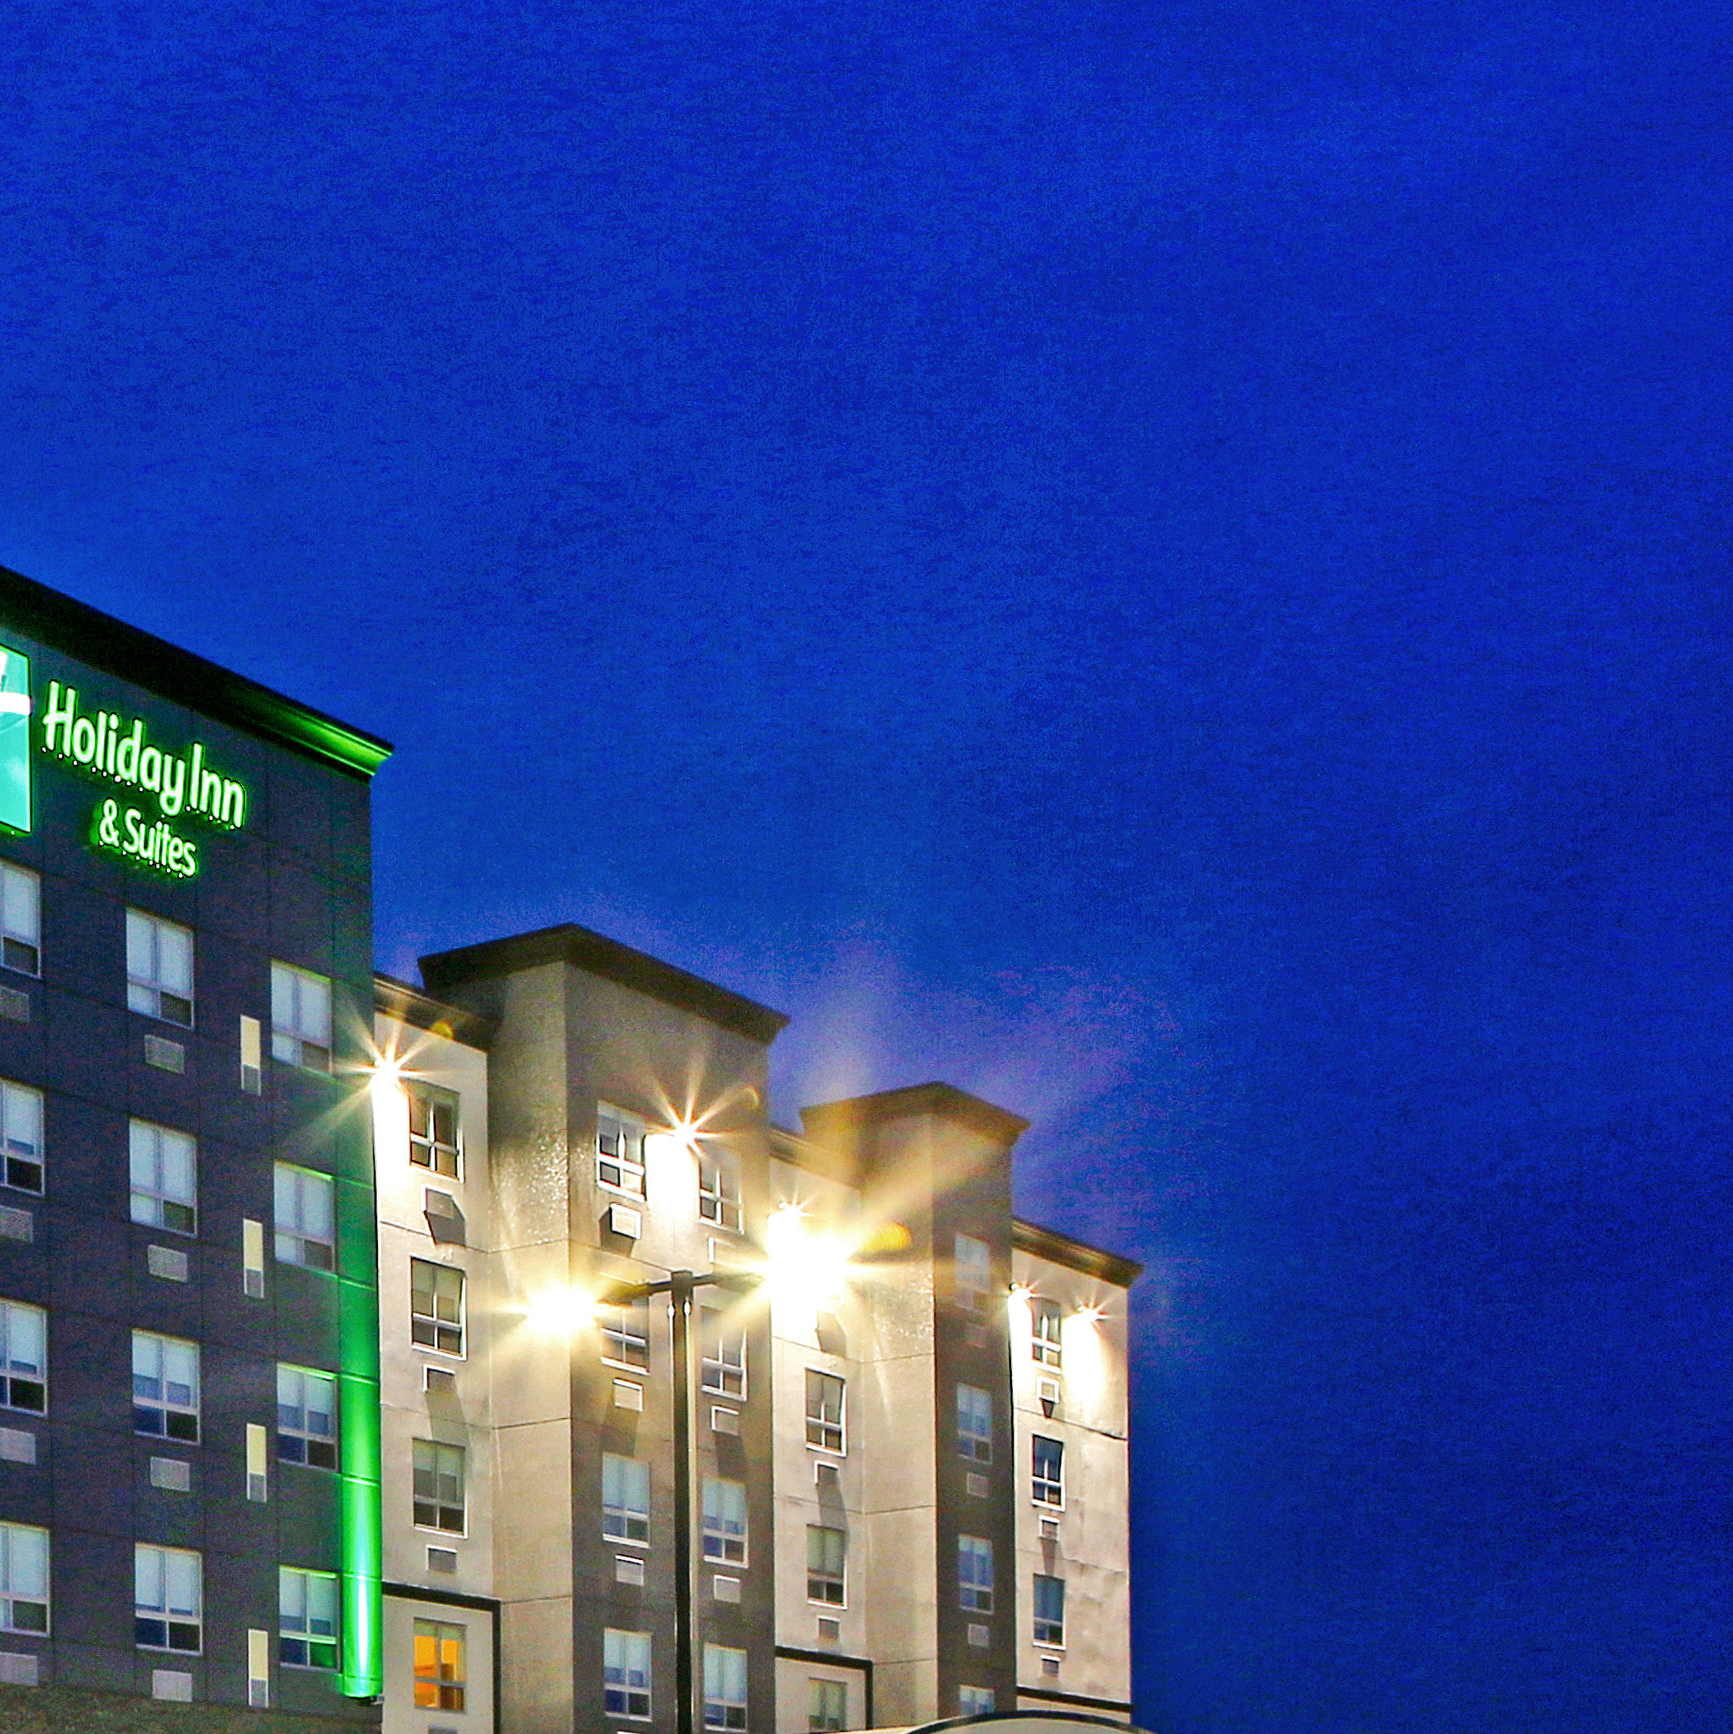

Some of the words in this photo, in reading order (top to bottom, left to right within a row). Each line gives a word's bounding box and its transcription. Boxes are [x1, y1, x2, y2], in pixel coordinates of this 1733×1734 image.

[42, 680, 185, 817] Holiday
[189, 742, 245, 828] Inn
[99, 798, 119, 847] &
[122, 808, 197, 877] Suites
